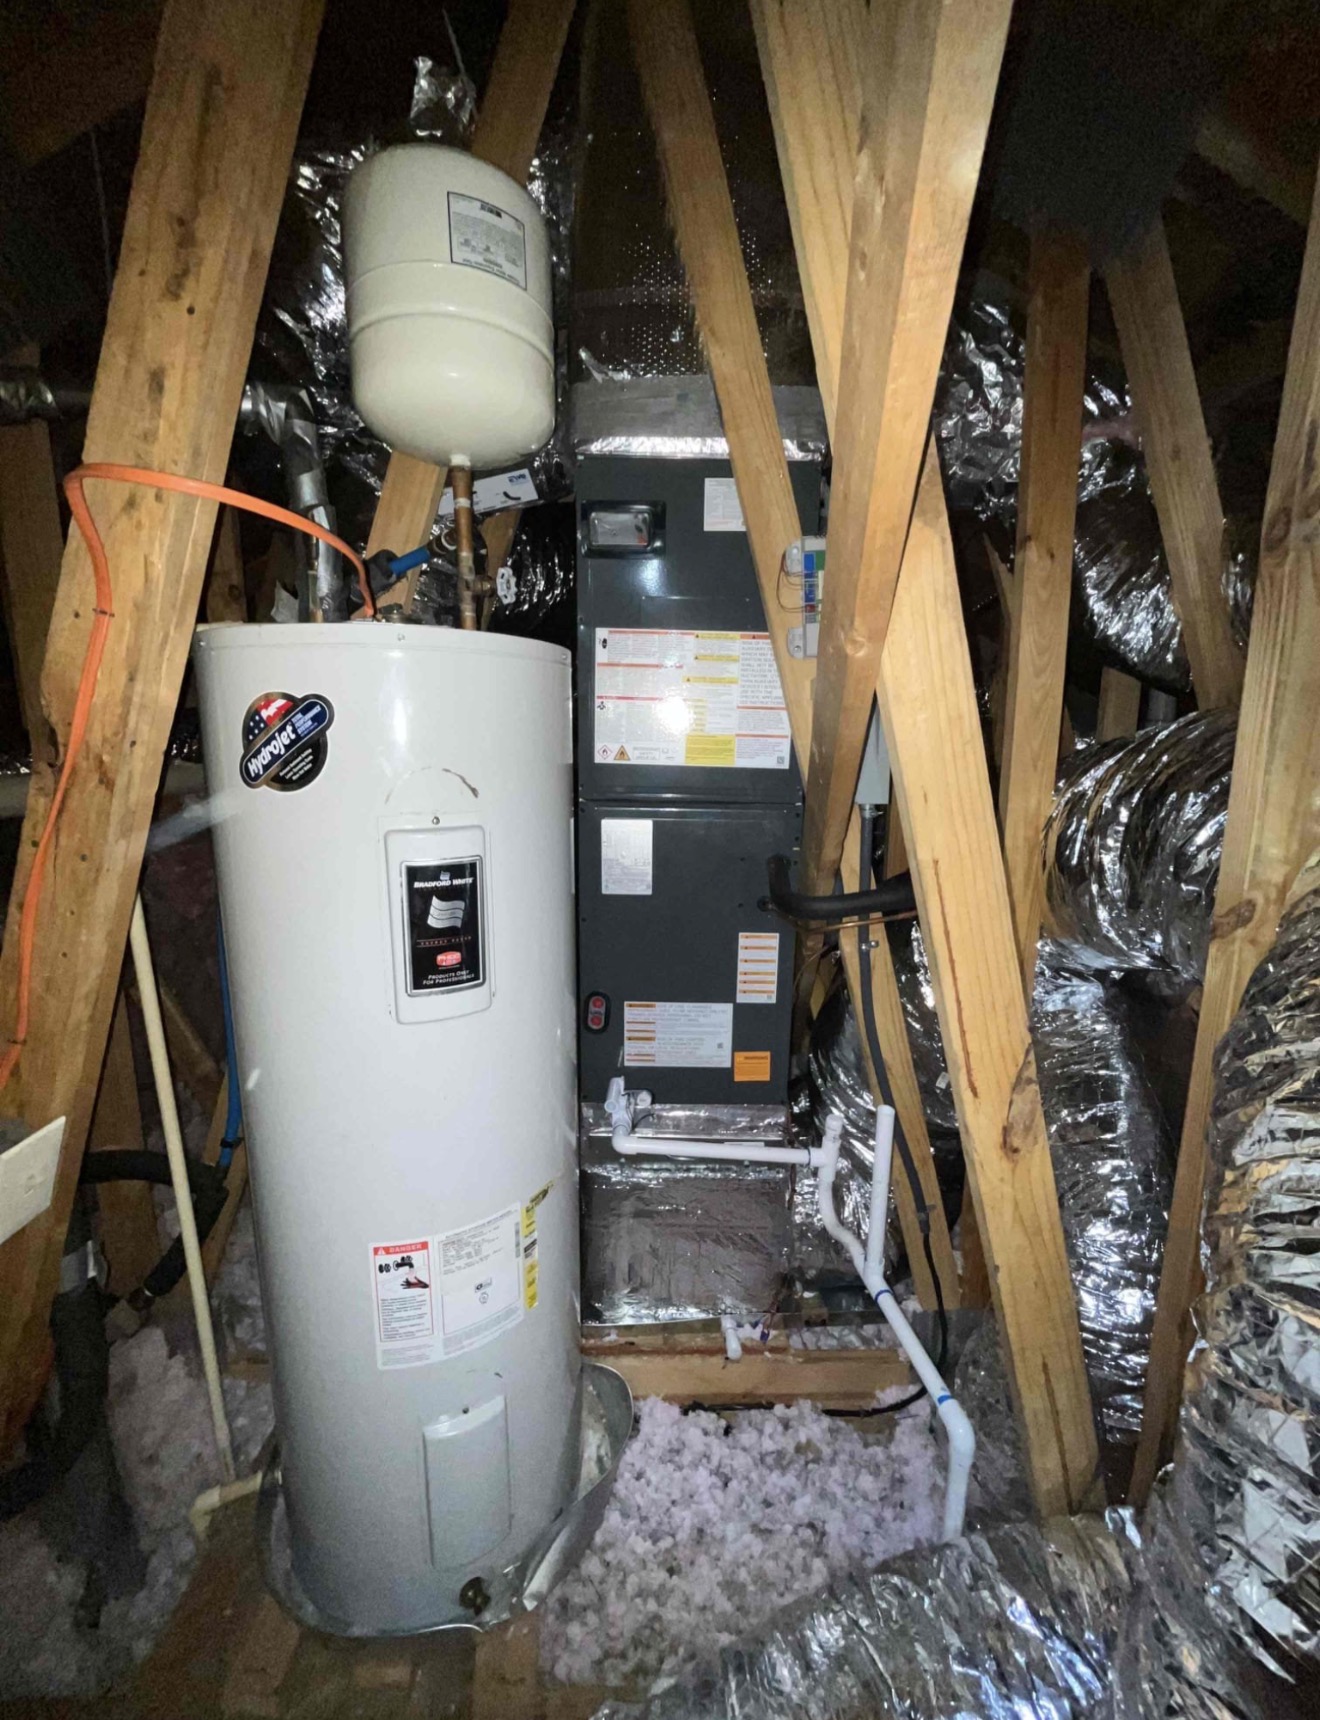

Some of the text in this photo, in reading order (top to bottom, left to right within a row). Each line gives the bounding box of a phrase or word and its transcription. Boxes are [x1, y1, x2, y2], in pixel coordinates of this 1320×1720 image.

[247, 722, 296, 778] Hydrojet
[413, 877, 473, 888] BRADFORD WHITE
[389, 1244, 422, 1253] DANGER
